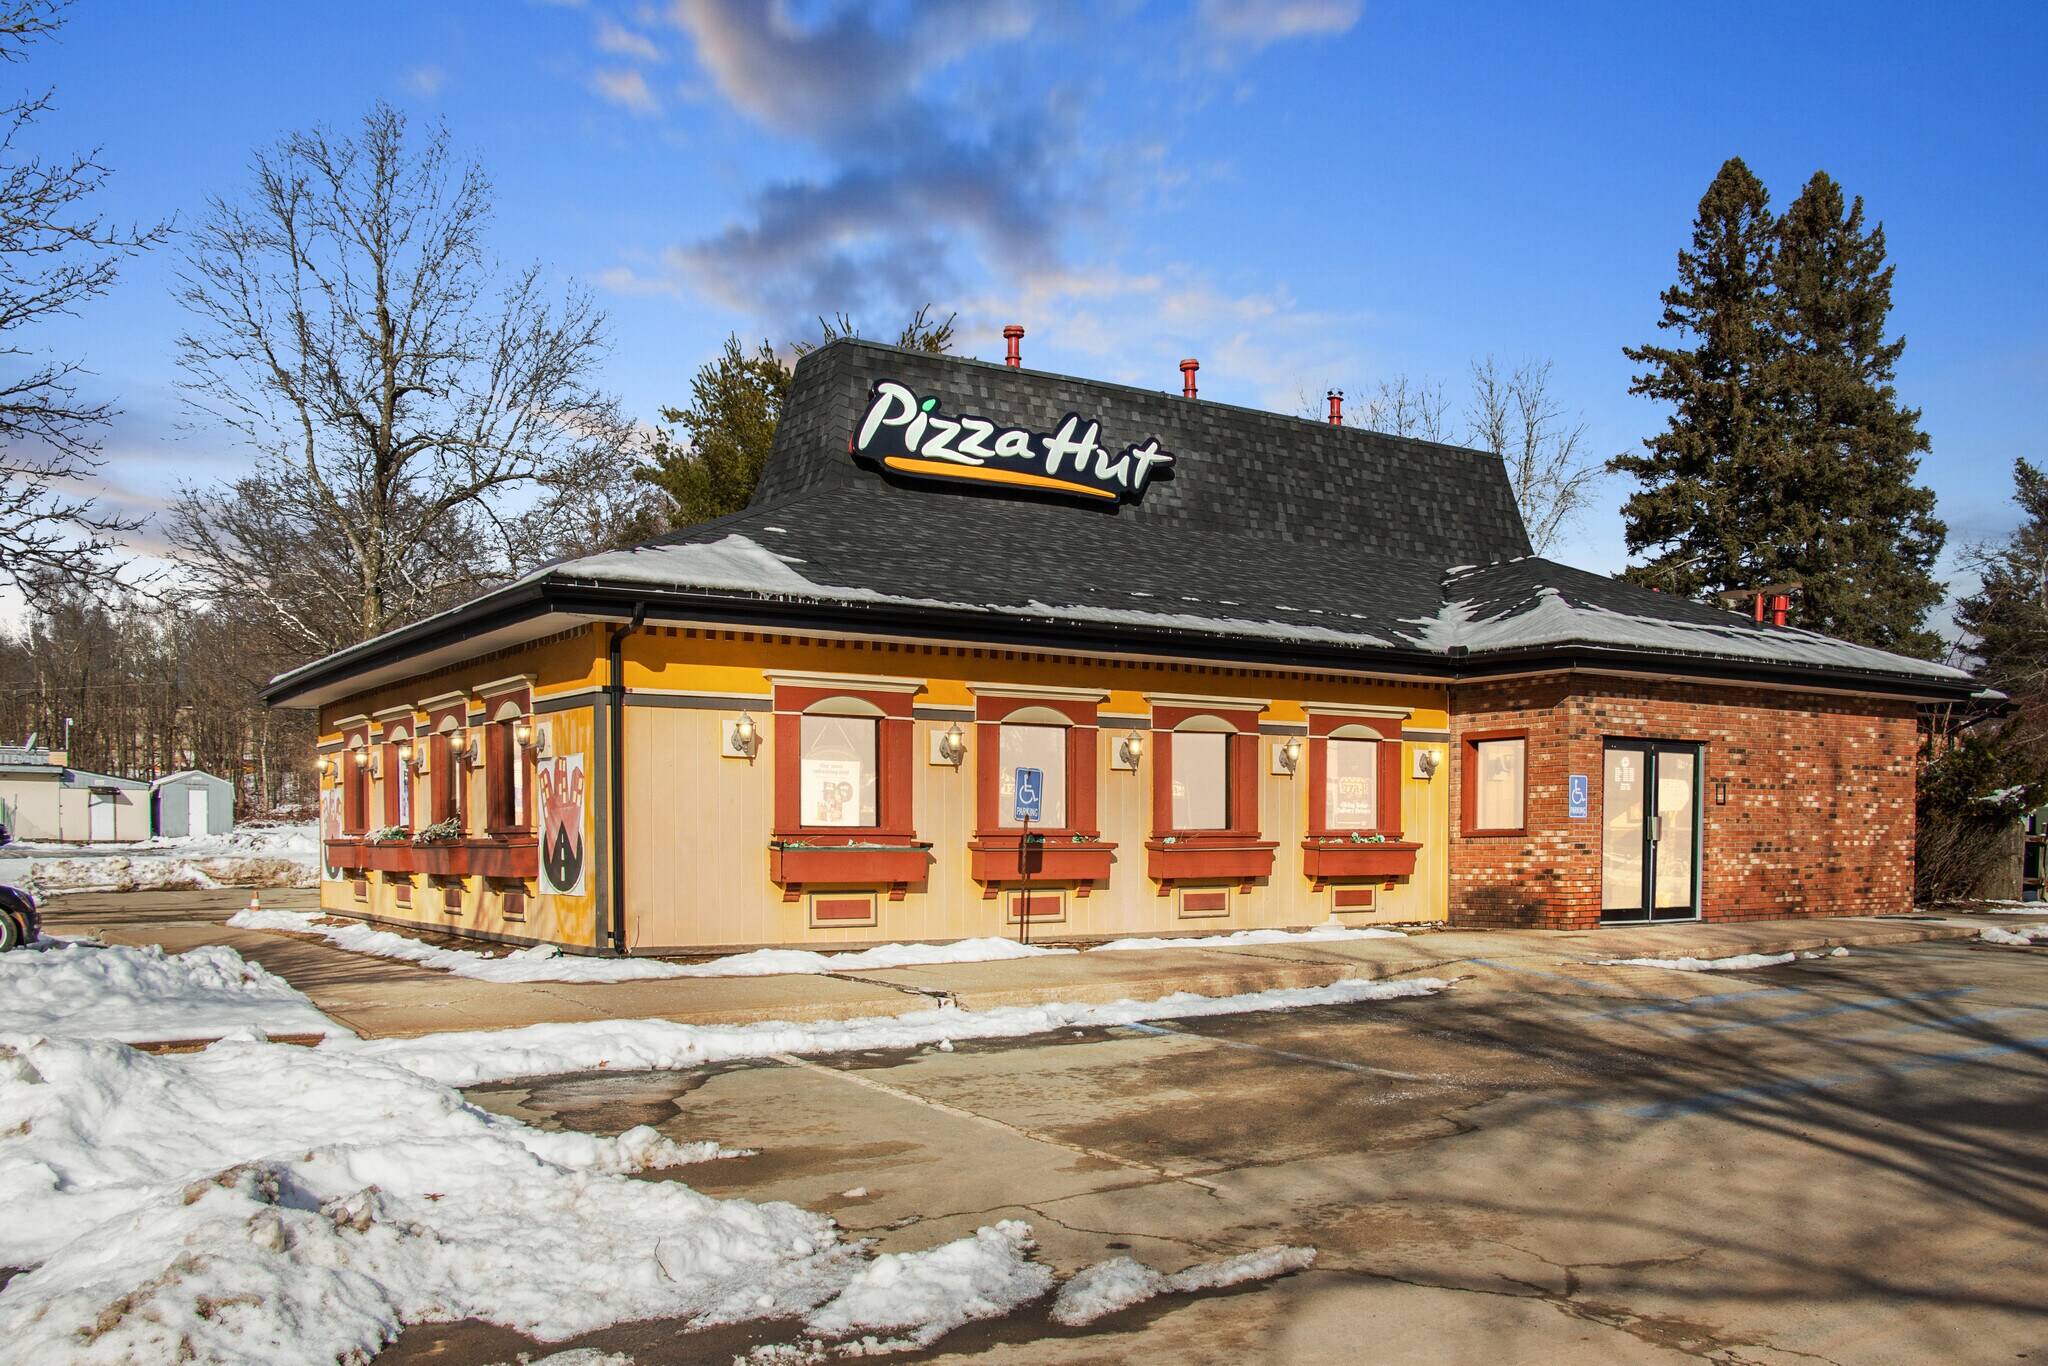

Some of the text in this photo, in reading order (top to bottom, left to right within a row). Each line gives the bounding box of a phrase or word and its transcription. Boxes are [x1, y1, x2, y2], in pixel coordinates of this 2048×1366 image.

[858, 382, 1174, 489] Pizza Hut
[1017, 806, 1038, 817] PARKING
